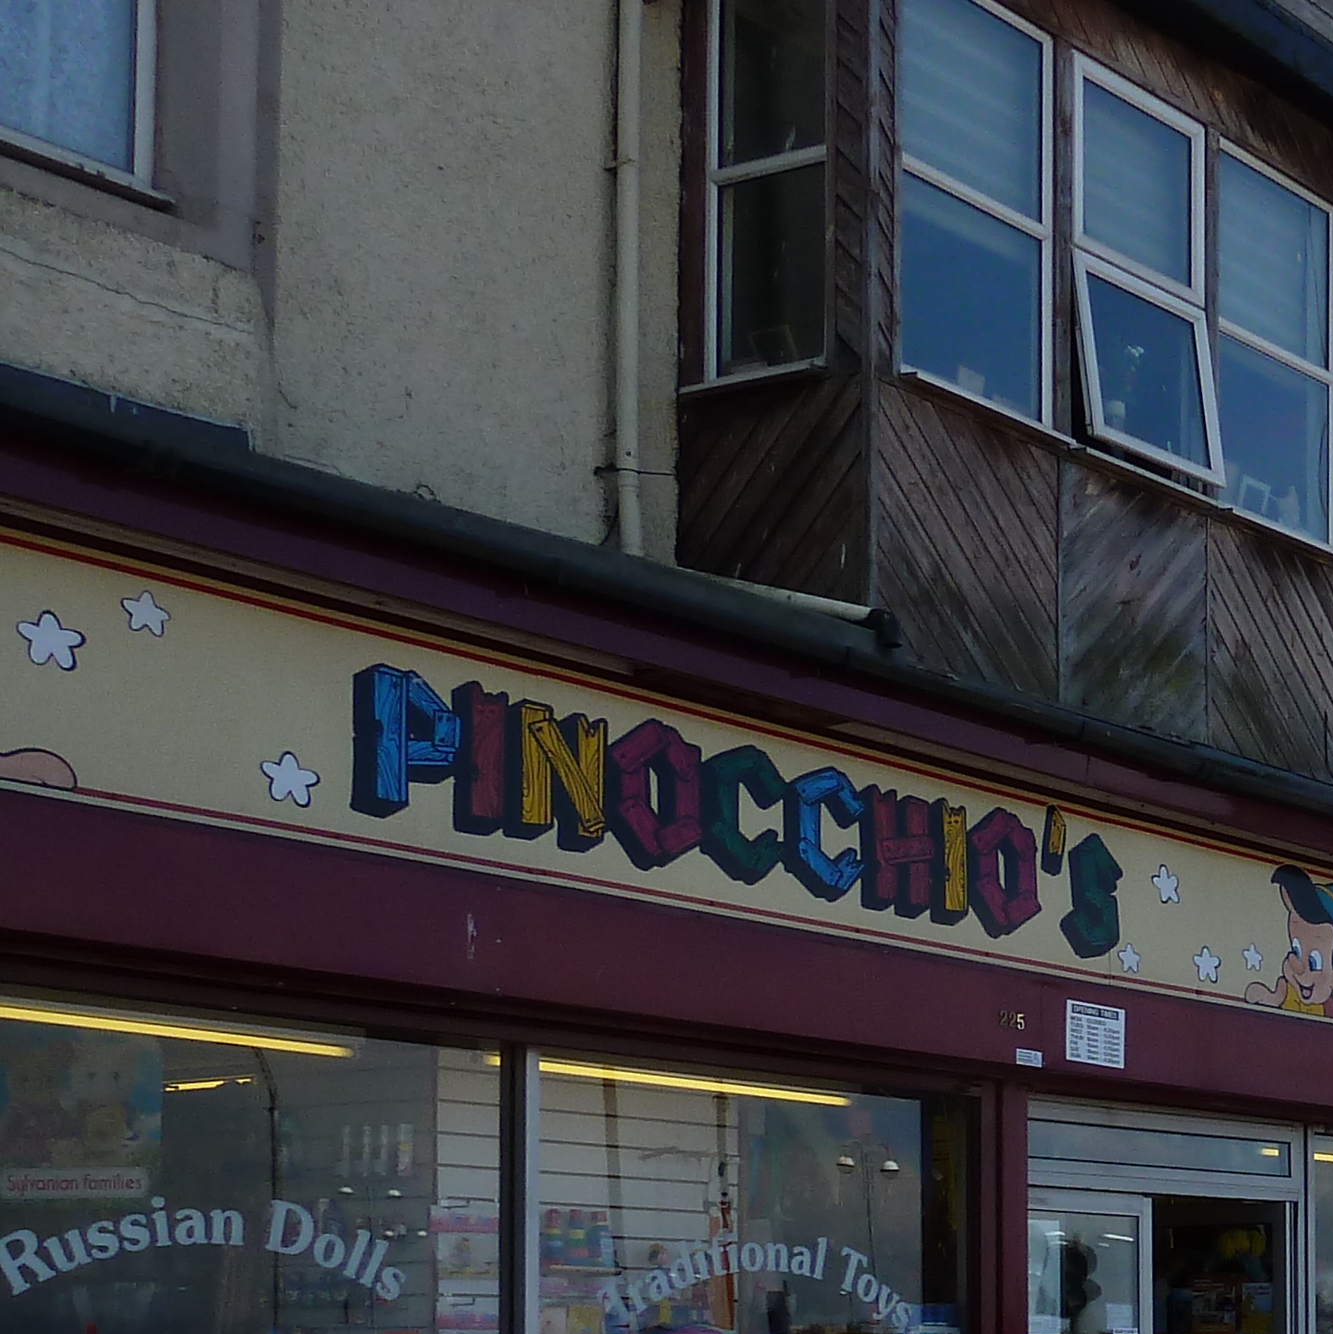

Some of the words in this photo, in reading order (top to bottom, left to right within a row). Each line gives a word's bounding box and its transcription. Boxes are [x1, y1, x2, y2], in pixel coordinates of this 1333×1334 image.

[351, 663, 1124, 959] PINOCCHIO'S
[999, 1009, 1026, 1031] 225
[6, 1173, 78, 1197] Sylvanian
[0, 1197, 245, 1296] Russian
[265, 1199, 408, 1302] Dolls
[598, 1236, 828, 1320] Traditional
[840, 1245, 914, 1328] Toys
